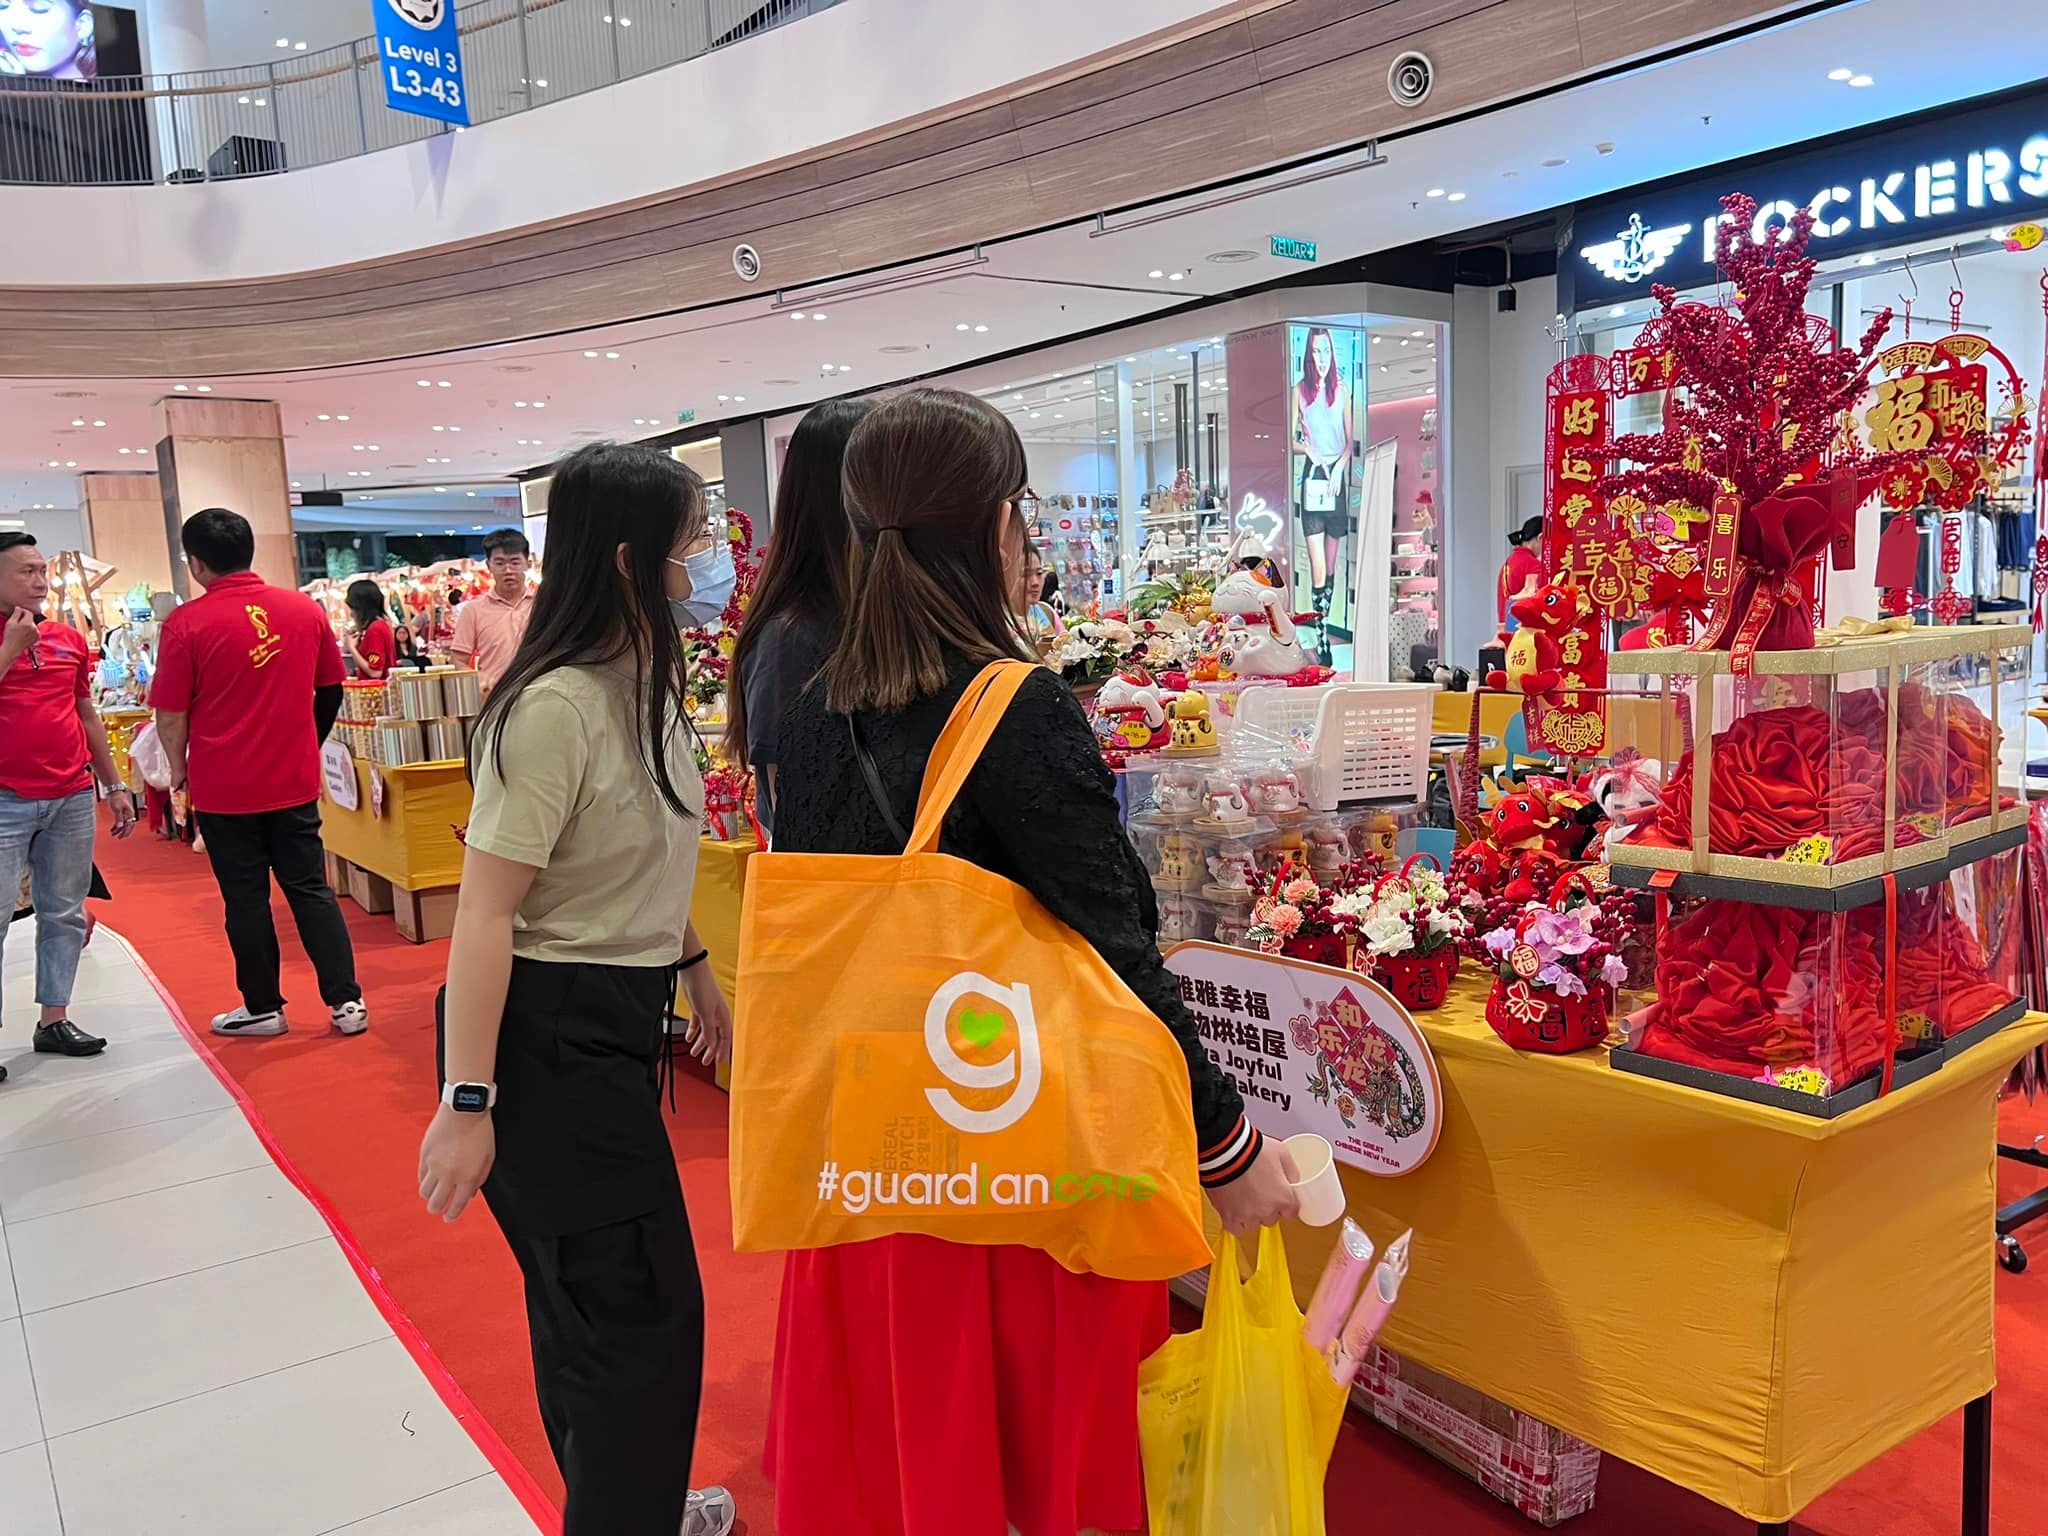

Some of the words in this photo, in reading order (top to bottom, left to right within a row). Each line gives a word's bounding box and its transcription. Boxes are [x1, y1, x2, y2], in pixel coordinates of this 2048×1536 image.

[384, 36, 441, 68] Level
[444, 52, 458, 73] 3
[389, 65, 461, 107] L3-43
[1272, 237, 1307, 259] KELUAR
[1865, 375, 1934, 454] 福
[1711, 512, 1735, 580] 喜乐
[1598, 577, 1618, 597] 福
[1511, 649, 1527, 667] 福
[1514, 949, 1537, 974] 福
[1226, 1049, 1282, 1080] Joyful
[899, 1116, 914, 1172] PATCH
[1347, 1135, 1361, 1146] THE
[1362, 1141, 1384, 1153] GREAT
[1363, 1149, 1380, 1161] NEW
[1381, 1156, 1400, 1168] YEAR
